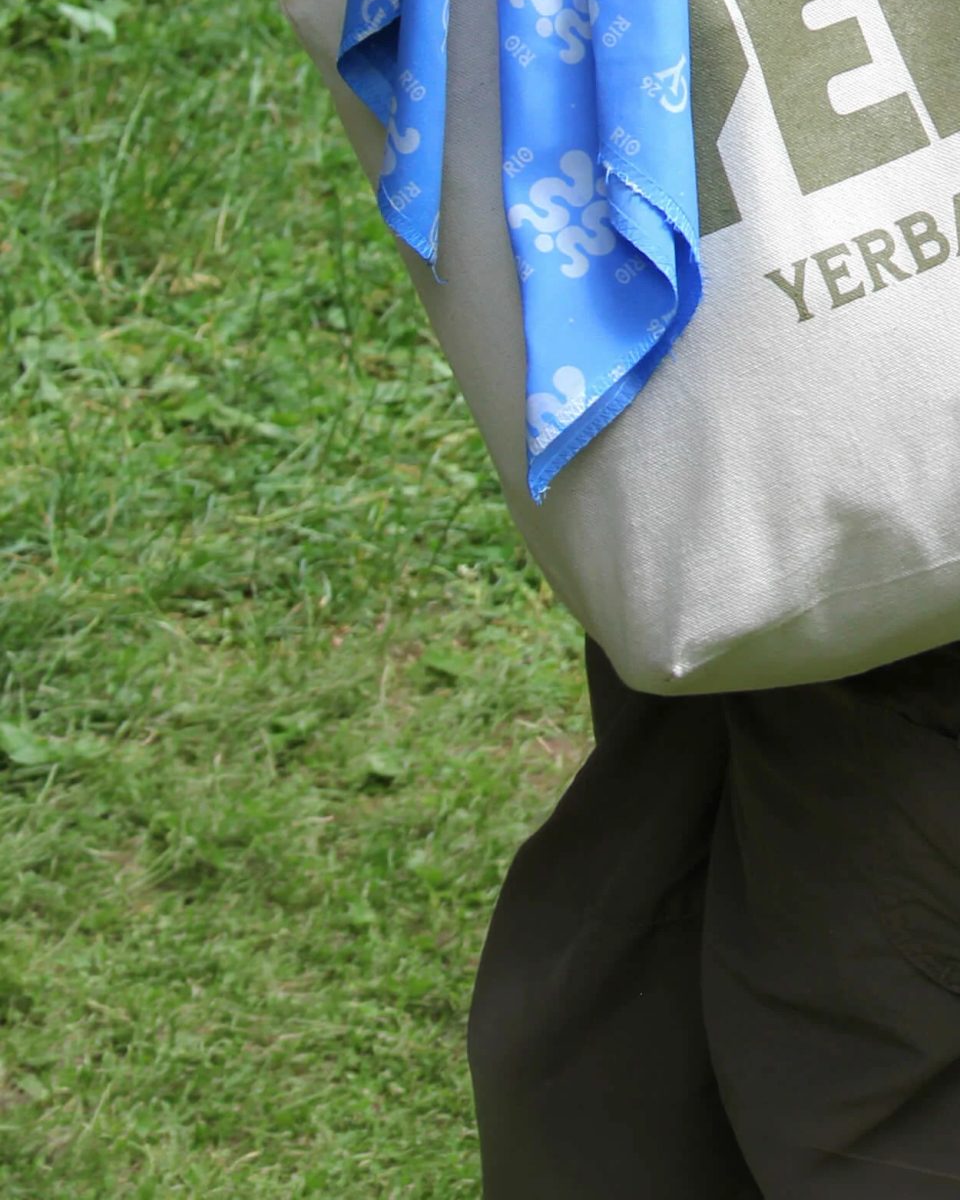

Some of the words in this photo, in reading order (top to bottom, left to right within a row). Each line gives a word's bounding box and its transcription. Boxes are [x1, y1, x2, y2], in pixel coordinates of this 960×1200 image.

[602, 14, 632, 48] RIO
[504, 35, 537, 68] RIO
[399, 69, 427, 102] RIO
[640, 76, 662, 98] 26
[609, 126, 641, 157] RIO
[503, 147, 534, 179] RIO
